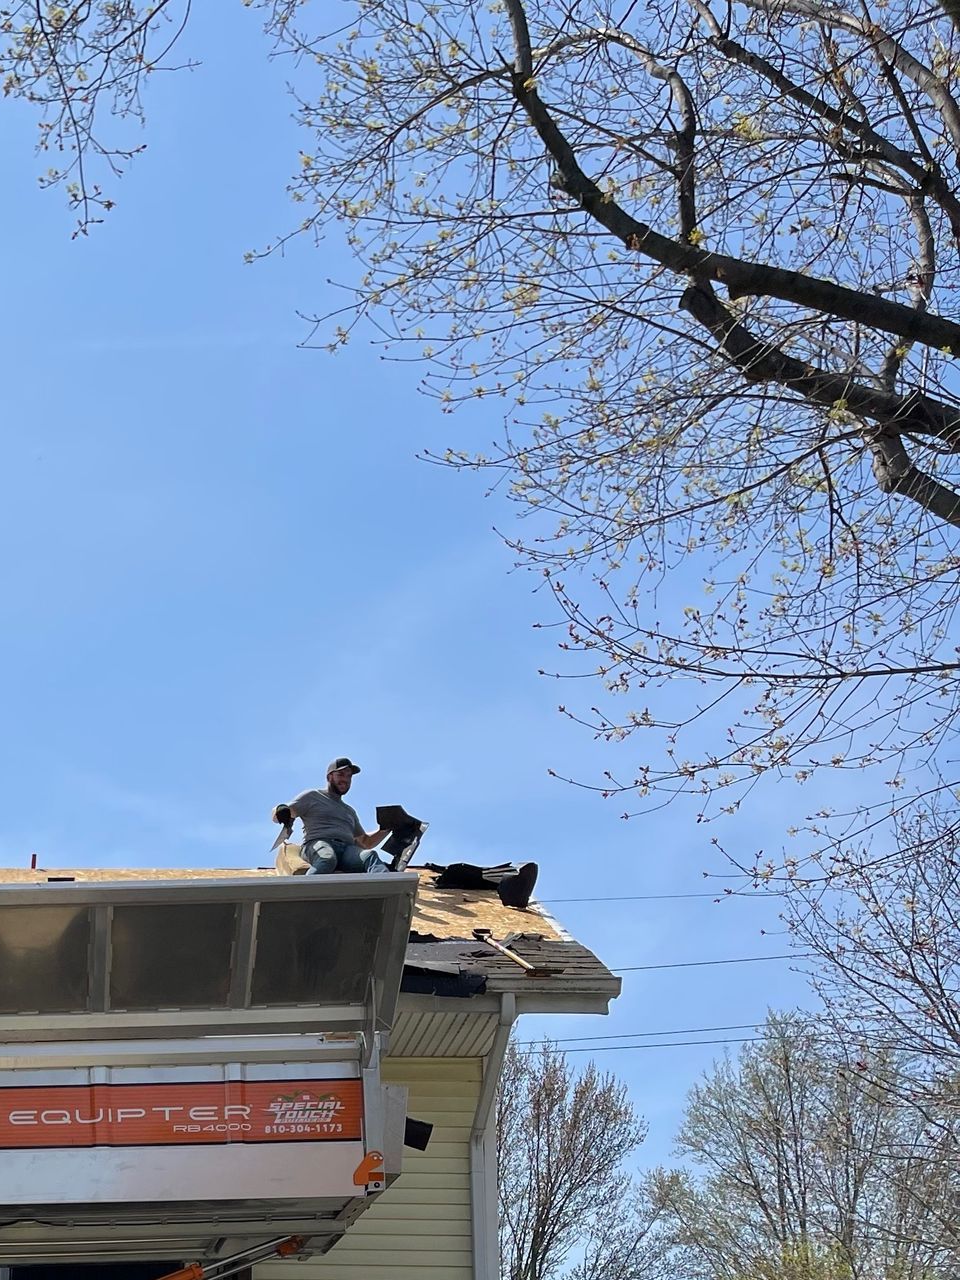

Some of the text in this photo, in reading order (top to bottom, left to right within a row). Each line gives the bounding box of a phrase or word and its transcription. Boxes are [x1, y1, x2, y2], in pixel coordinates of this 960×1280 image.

[265, 1101, 346, 1111] SPECIAL
[8, 1105, 251, 1125] EQUIPTER
[273, 1110, 337, 1120] TOUCH
[172, 1123, 252, 1133] RB4000
[264, 1123, 343, 1134] 810-304-1173
